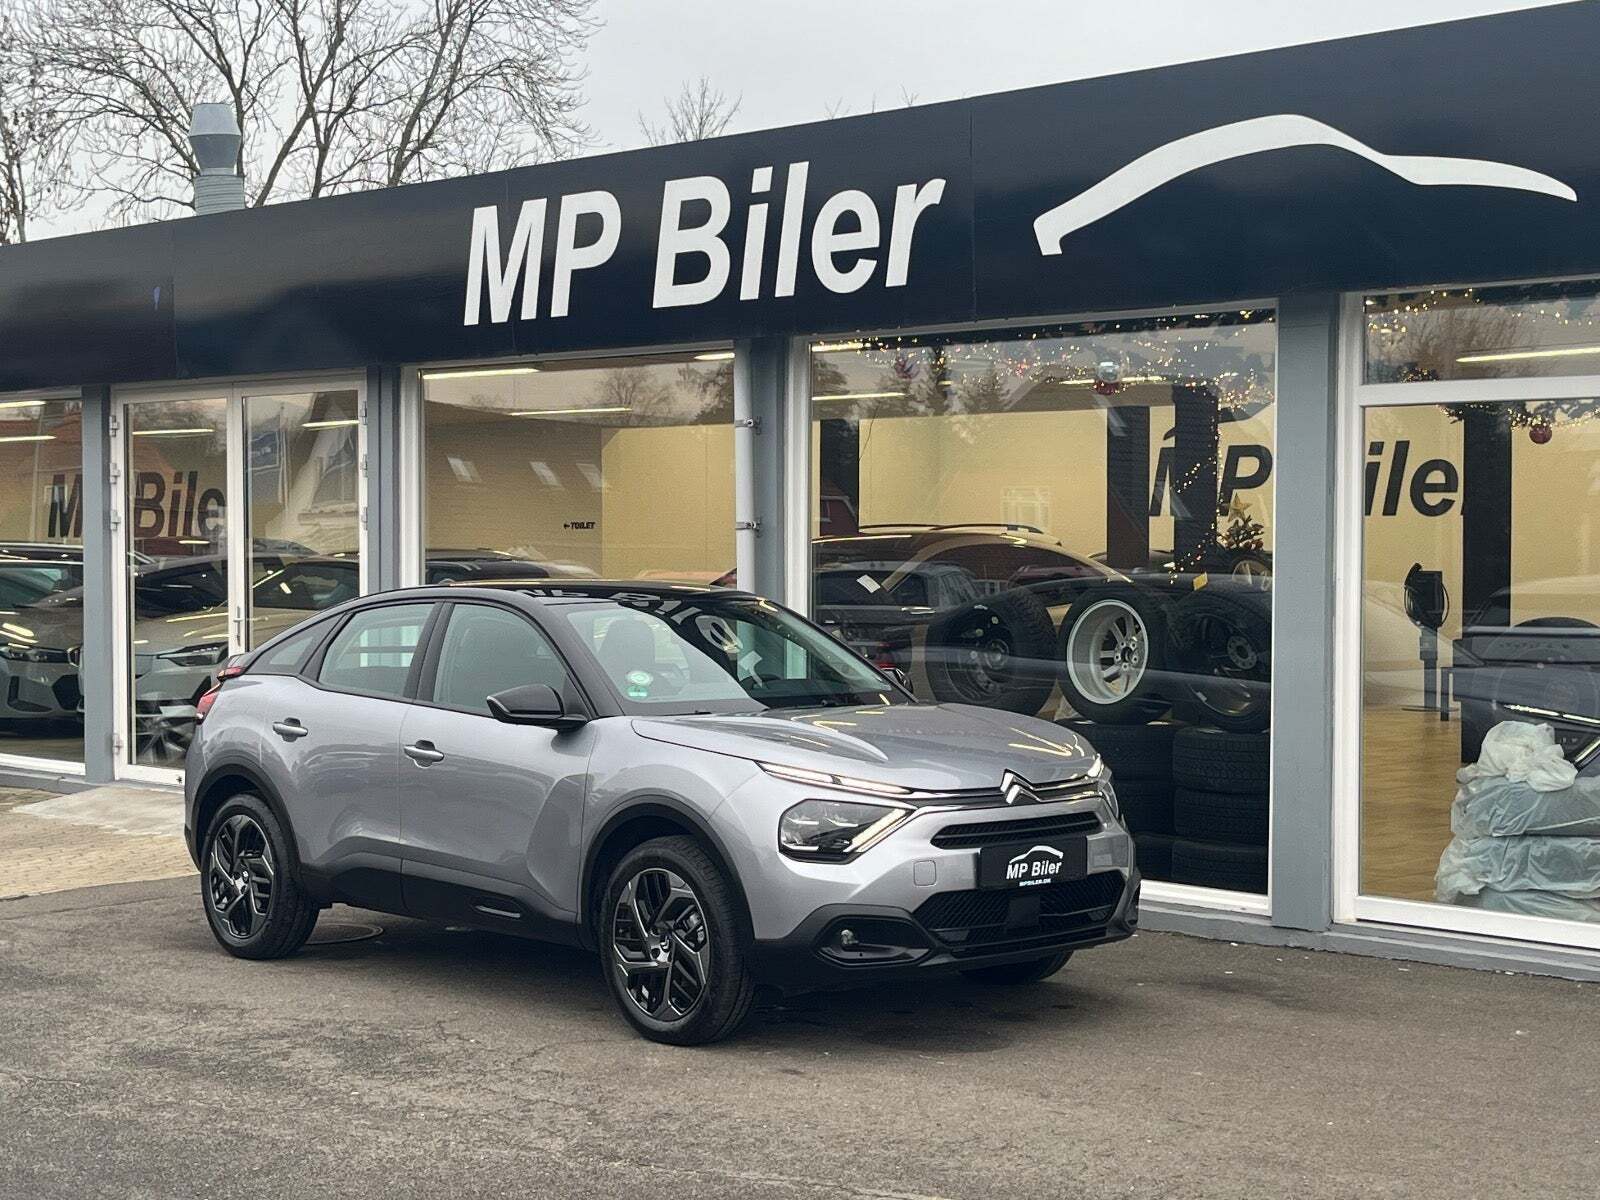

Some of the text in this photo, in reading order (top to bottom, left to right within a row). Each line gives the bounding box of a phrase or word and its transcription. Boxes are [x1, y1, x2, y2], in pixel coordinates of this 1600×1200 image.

[464, 161, 946, 326] MP Biler
[48, 471, 226, 540] M Bile
[1364, 440, 1464, 517] ile
[570, 521, 596, 530] TOILET
[1006, 859, 1062, 879] MP Biler
